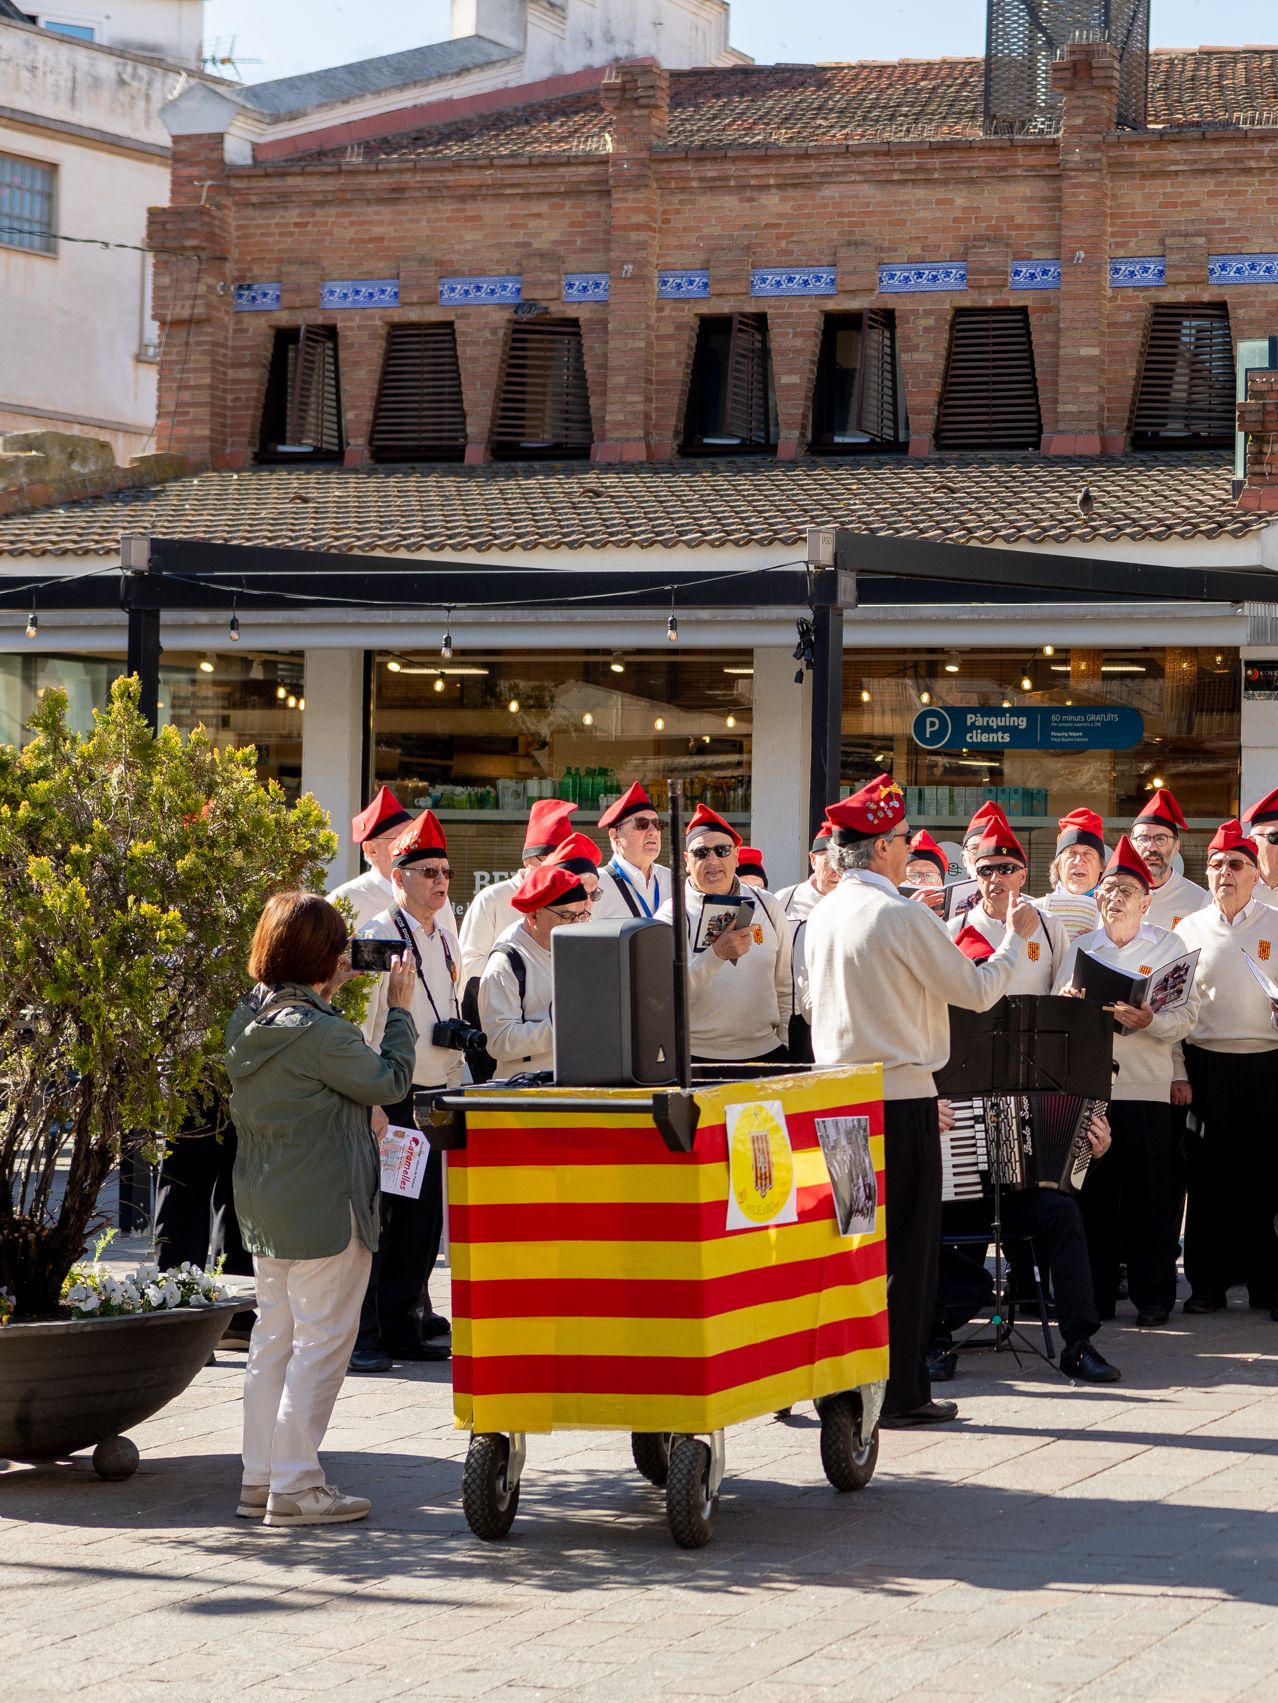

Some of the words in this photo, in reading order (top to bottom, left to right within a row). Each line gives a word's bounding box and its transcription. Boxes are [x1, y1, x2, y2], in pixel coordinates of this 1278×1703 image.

[966, 713, 1027, 729] Pàrquing
[1051, 714, 1061, 722] 60
[1062, 714, 1085, 722] minuts
[925, 717, 940, 739] P
[965, 730, 1011, 743] clients
[399, 1136, 420, 1191] Caramelles
